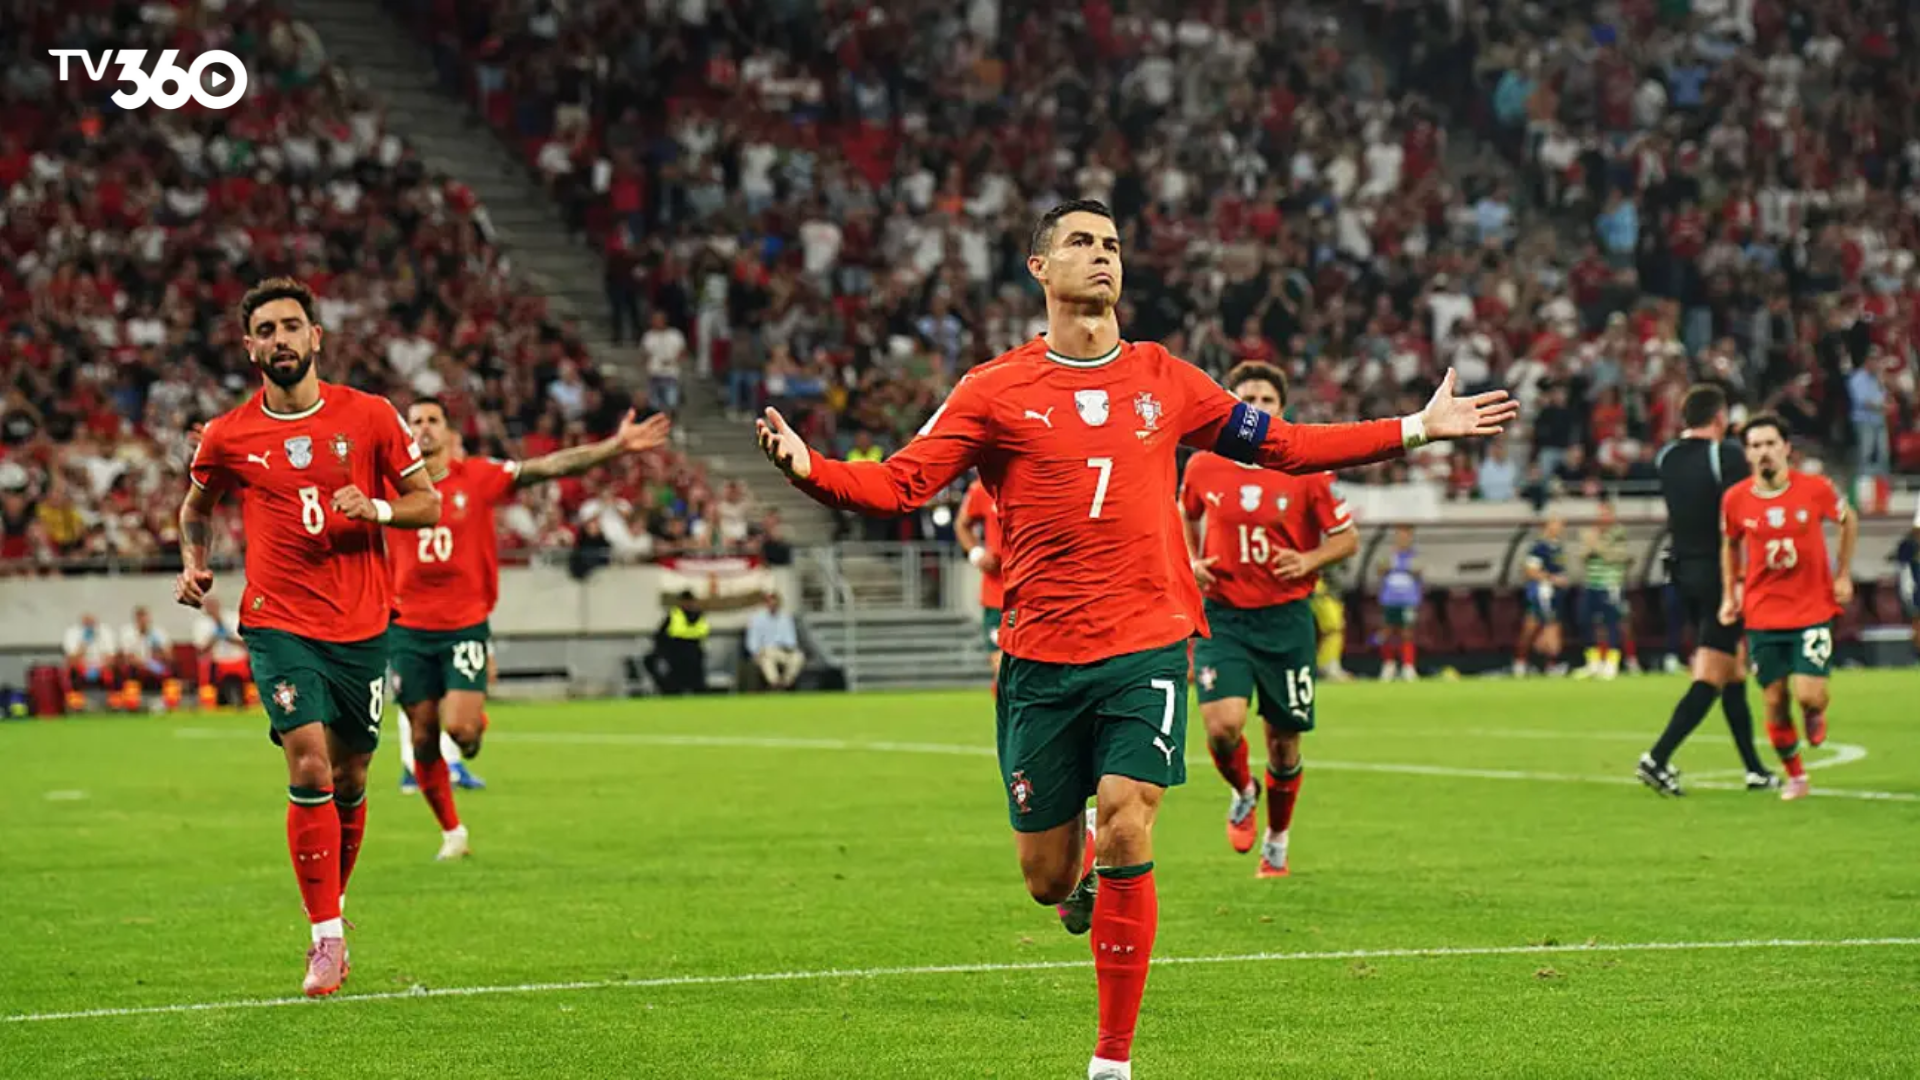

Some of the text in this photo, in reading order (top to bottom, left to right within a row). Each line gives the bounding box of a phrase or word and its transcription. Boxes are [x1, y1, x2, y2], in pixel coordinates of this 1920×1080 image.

[1088, 458, 1112, 520] 7
[299, 487, 325, 535] 8
[417, 527, 452, 563] 20
[1239, 525, 1270, 563] 15
[1766, 538, 1798, 570] 23
[453, 640, 486, 673] 20
[1803, 627, 1832, 661] 23
[369, 677, 384, 720] 8
[1285, 666, 1314, 707] 15
[1151, 679, 1175, 734] 7
